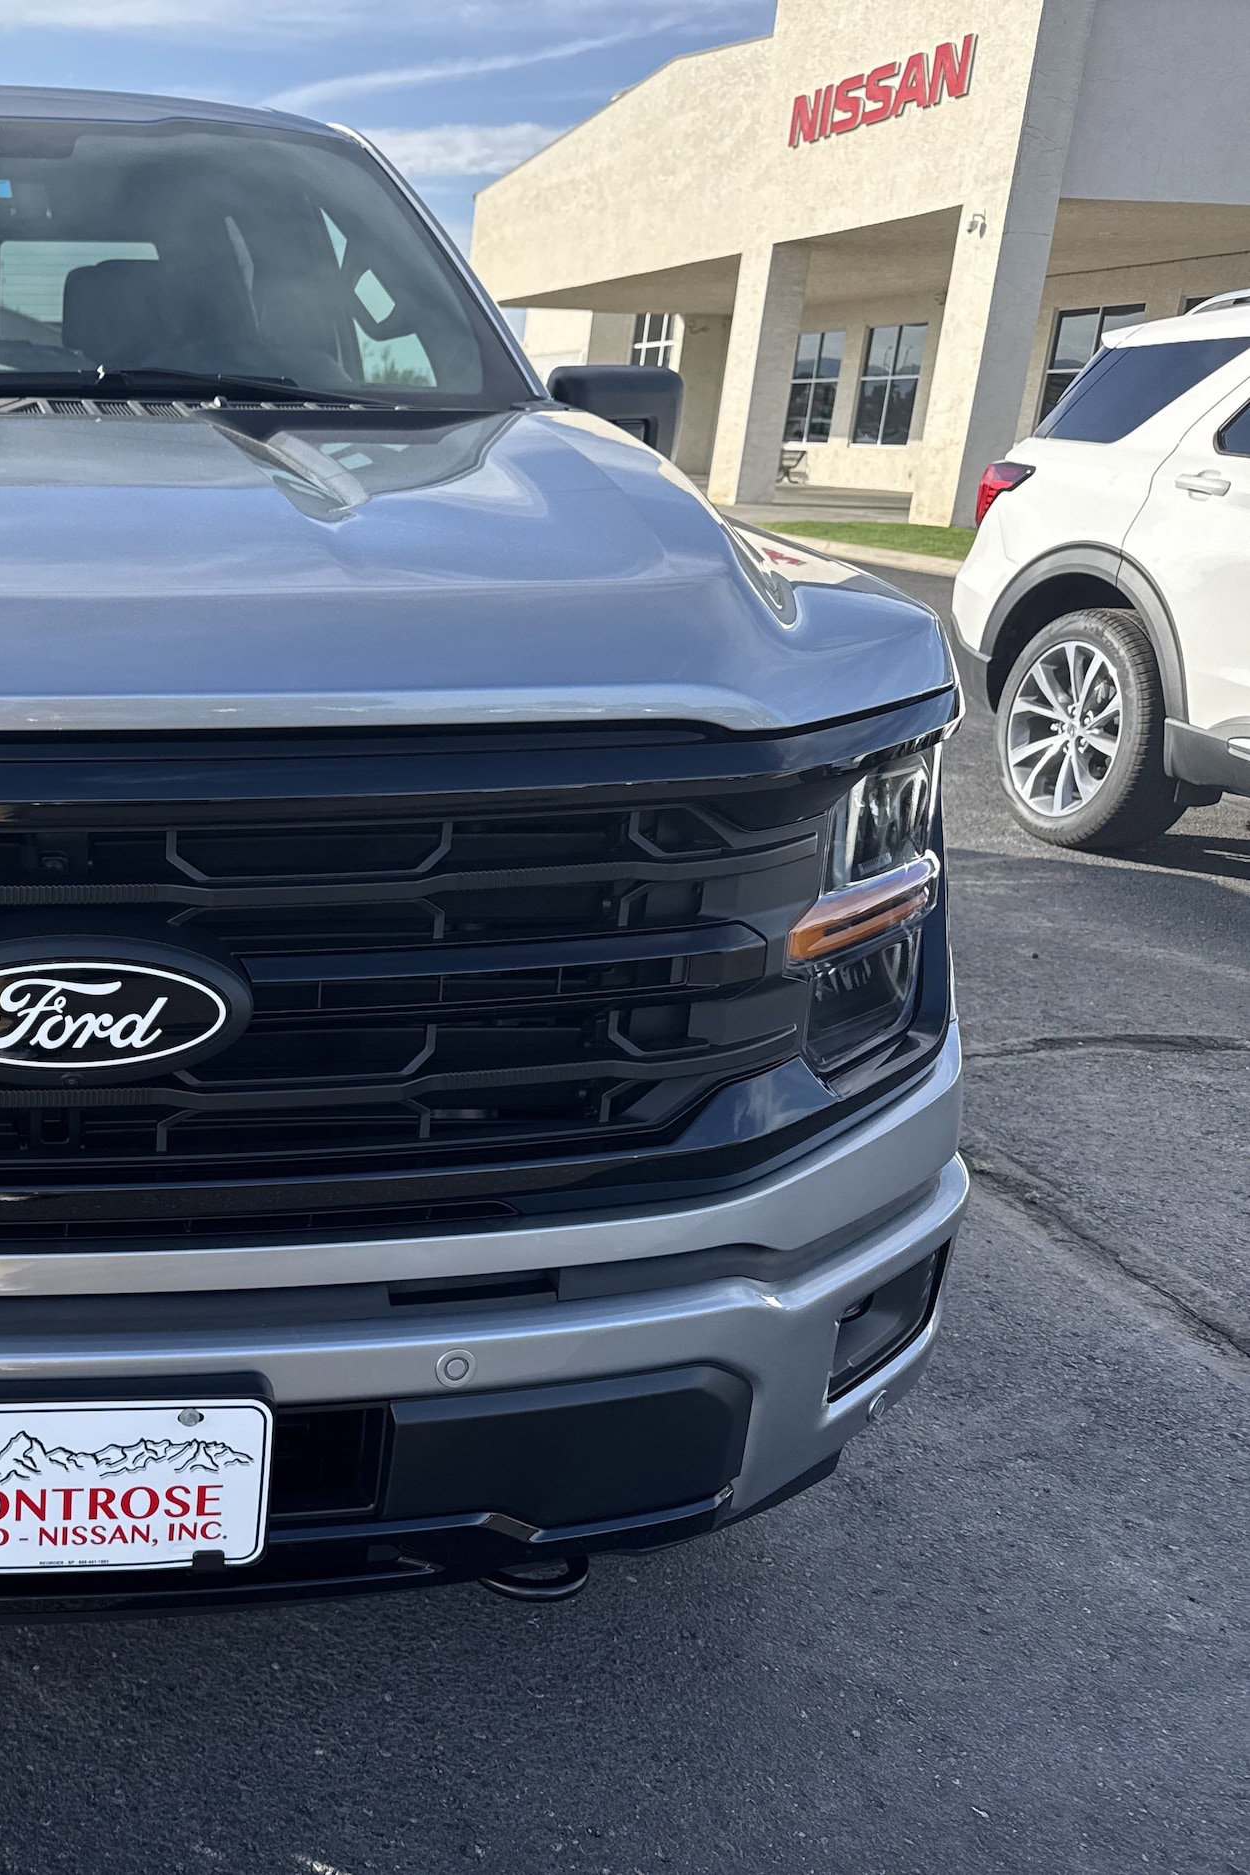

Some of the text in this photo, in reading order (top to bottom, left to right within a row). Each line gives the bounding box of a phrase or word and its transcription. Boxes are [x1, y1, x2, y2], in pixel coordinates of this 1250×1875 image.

[788, 33, 978, 149] NISSAN
[38, 1524, 159, 1547] NISSAN,
[167, 1521, 228, 1542] INC.
